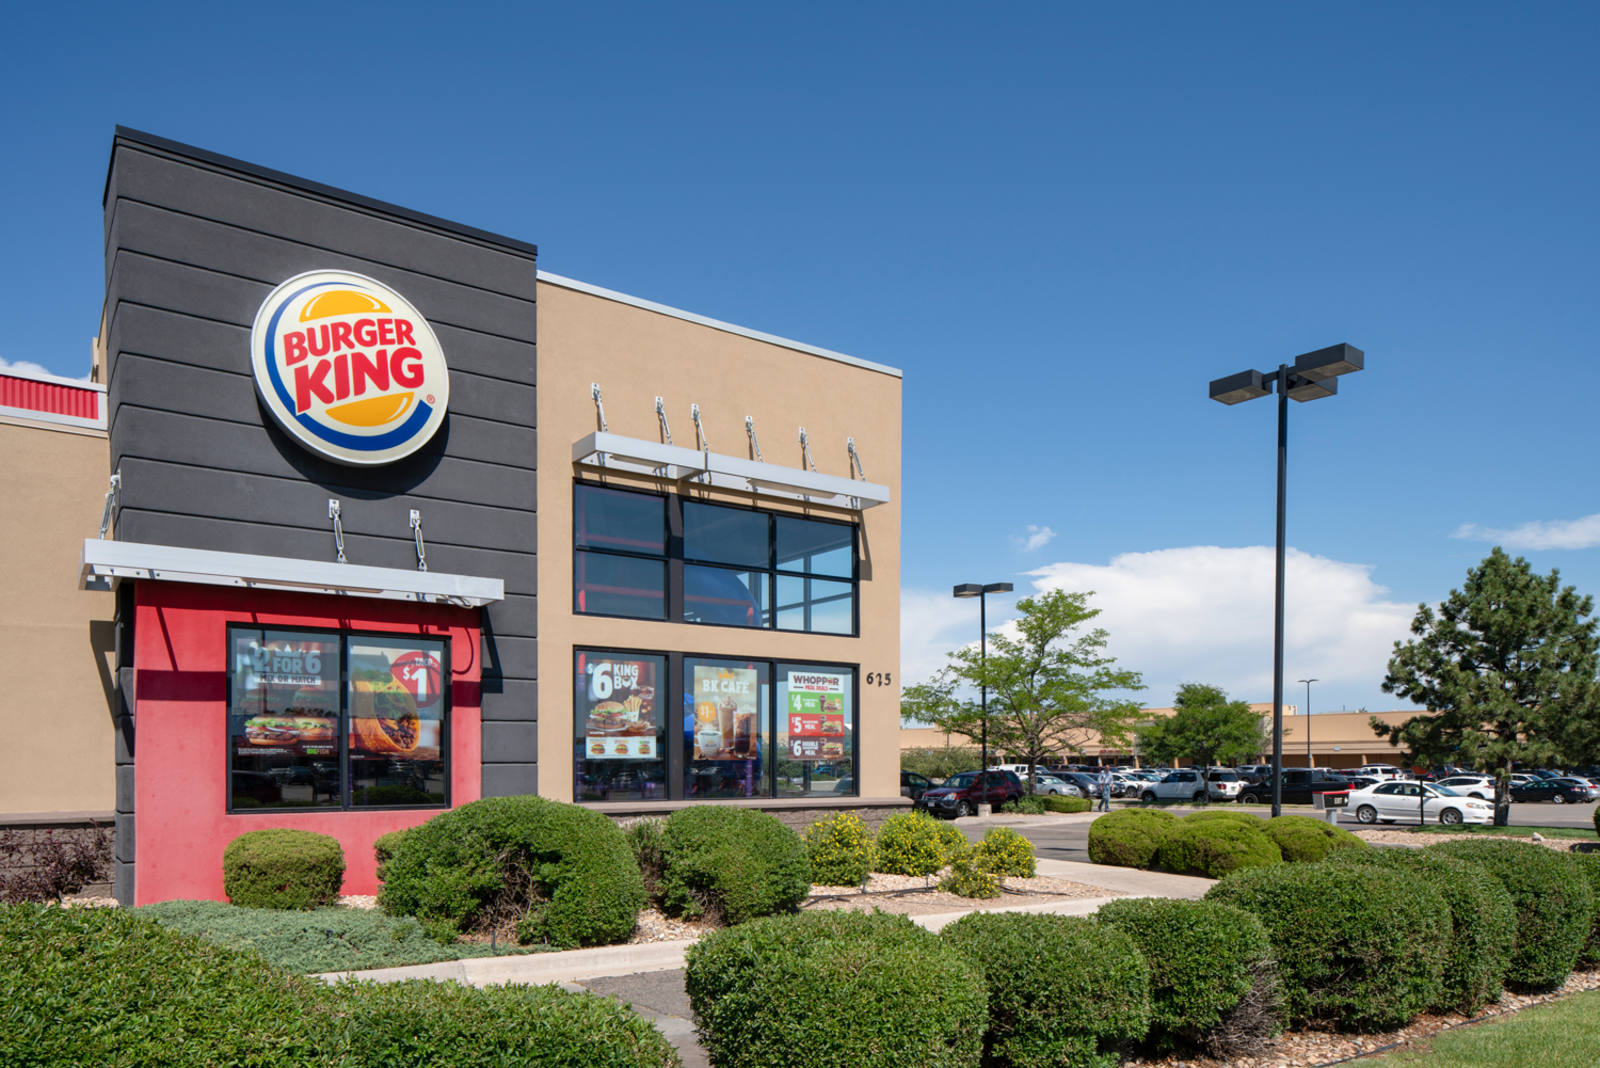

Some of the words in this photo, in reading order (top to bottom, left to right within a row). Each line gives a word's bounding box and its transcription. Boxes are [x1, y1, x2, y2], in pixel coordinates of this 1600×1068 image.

[283, 318, 416, 366] BURGER
[294, 347, 425, 413] KING
[272, 657, 303, 673] FOR
[613, 663, 639, 676] KING
[614, 676, 639, 690] BOX
[702, 679, 718, 693] BK
